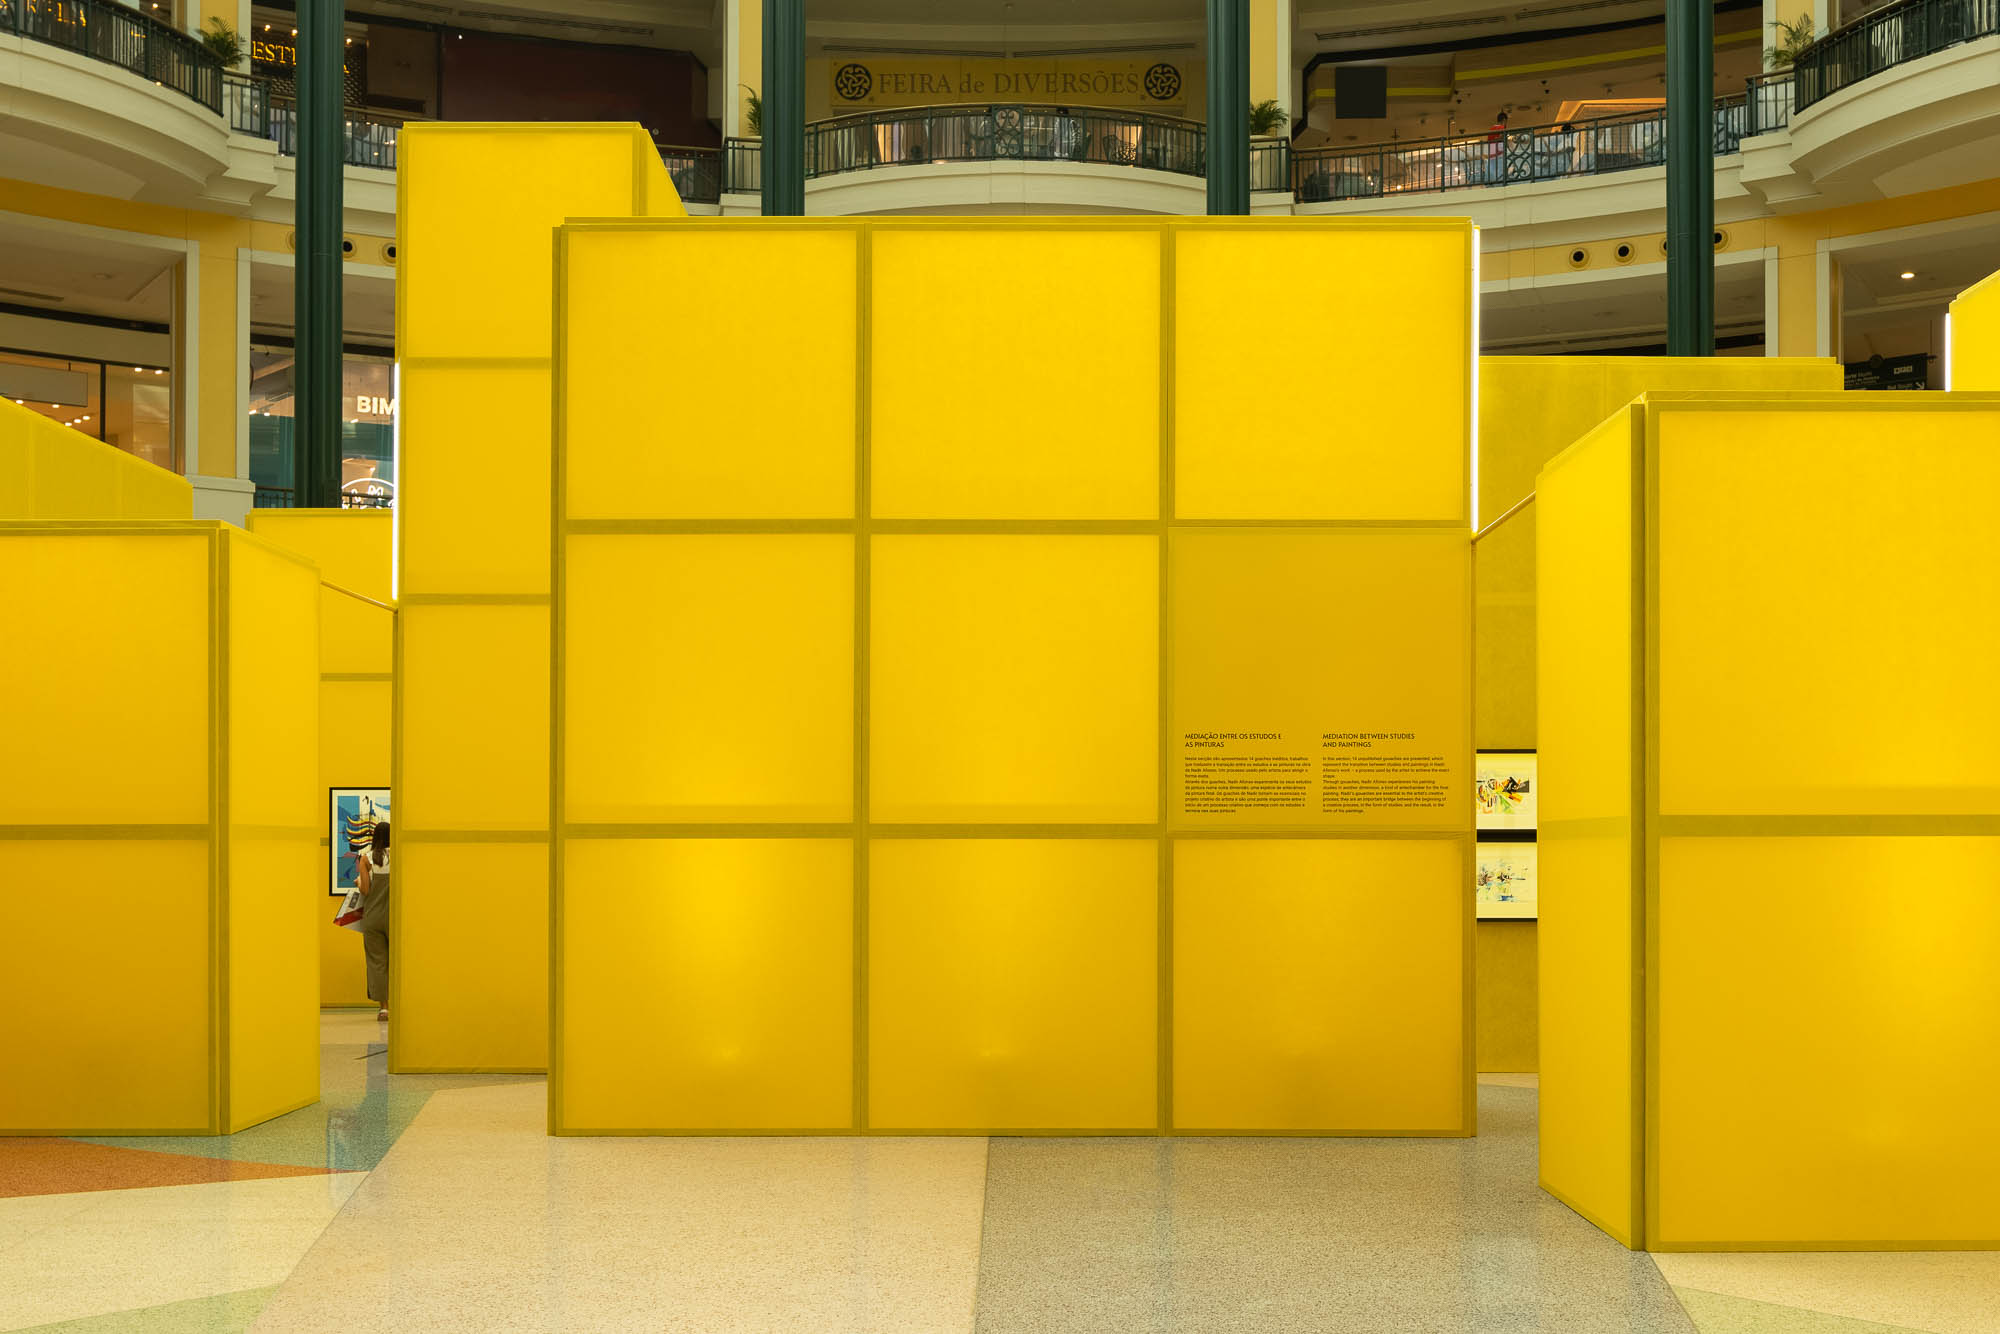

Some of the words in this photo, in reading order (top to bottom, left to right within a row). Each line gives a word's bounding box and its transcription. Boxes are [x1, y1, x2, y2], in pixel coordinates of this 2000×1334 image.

[879, 73, 951, 94] FEIRA
[959, 74, 985, 93] de
[994, 70, 1139, 94] DIVERSÕES
[1185, 732, 1218, 740] MEDIAÇÃO
